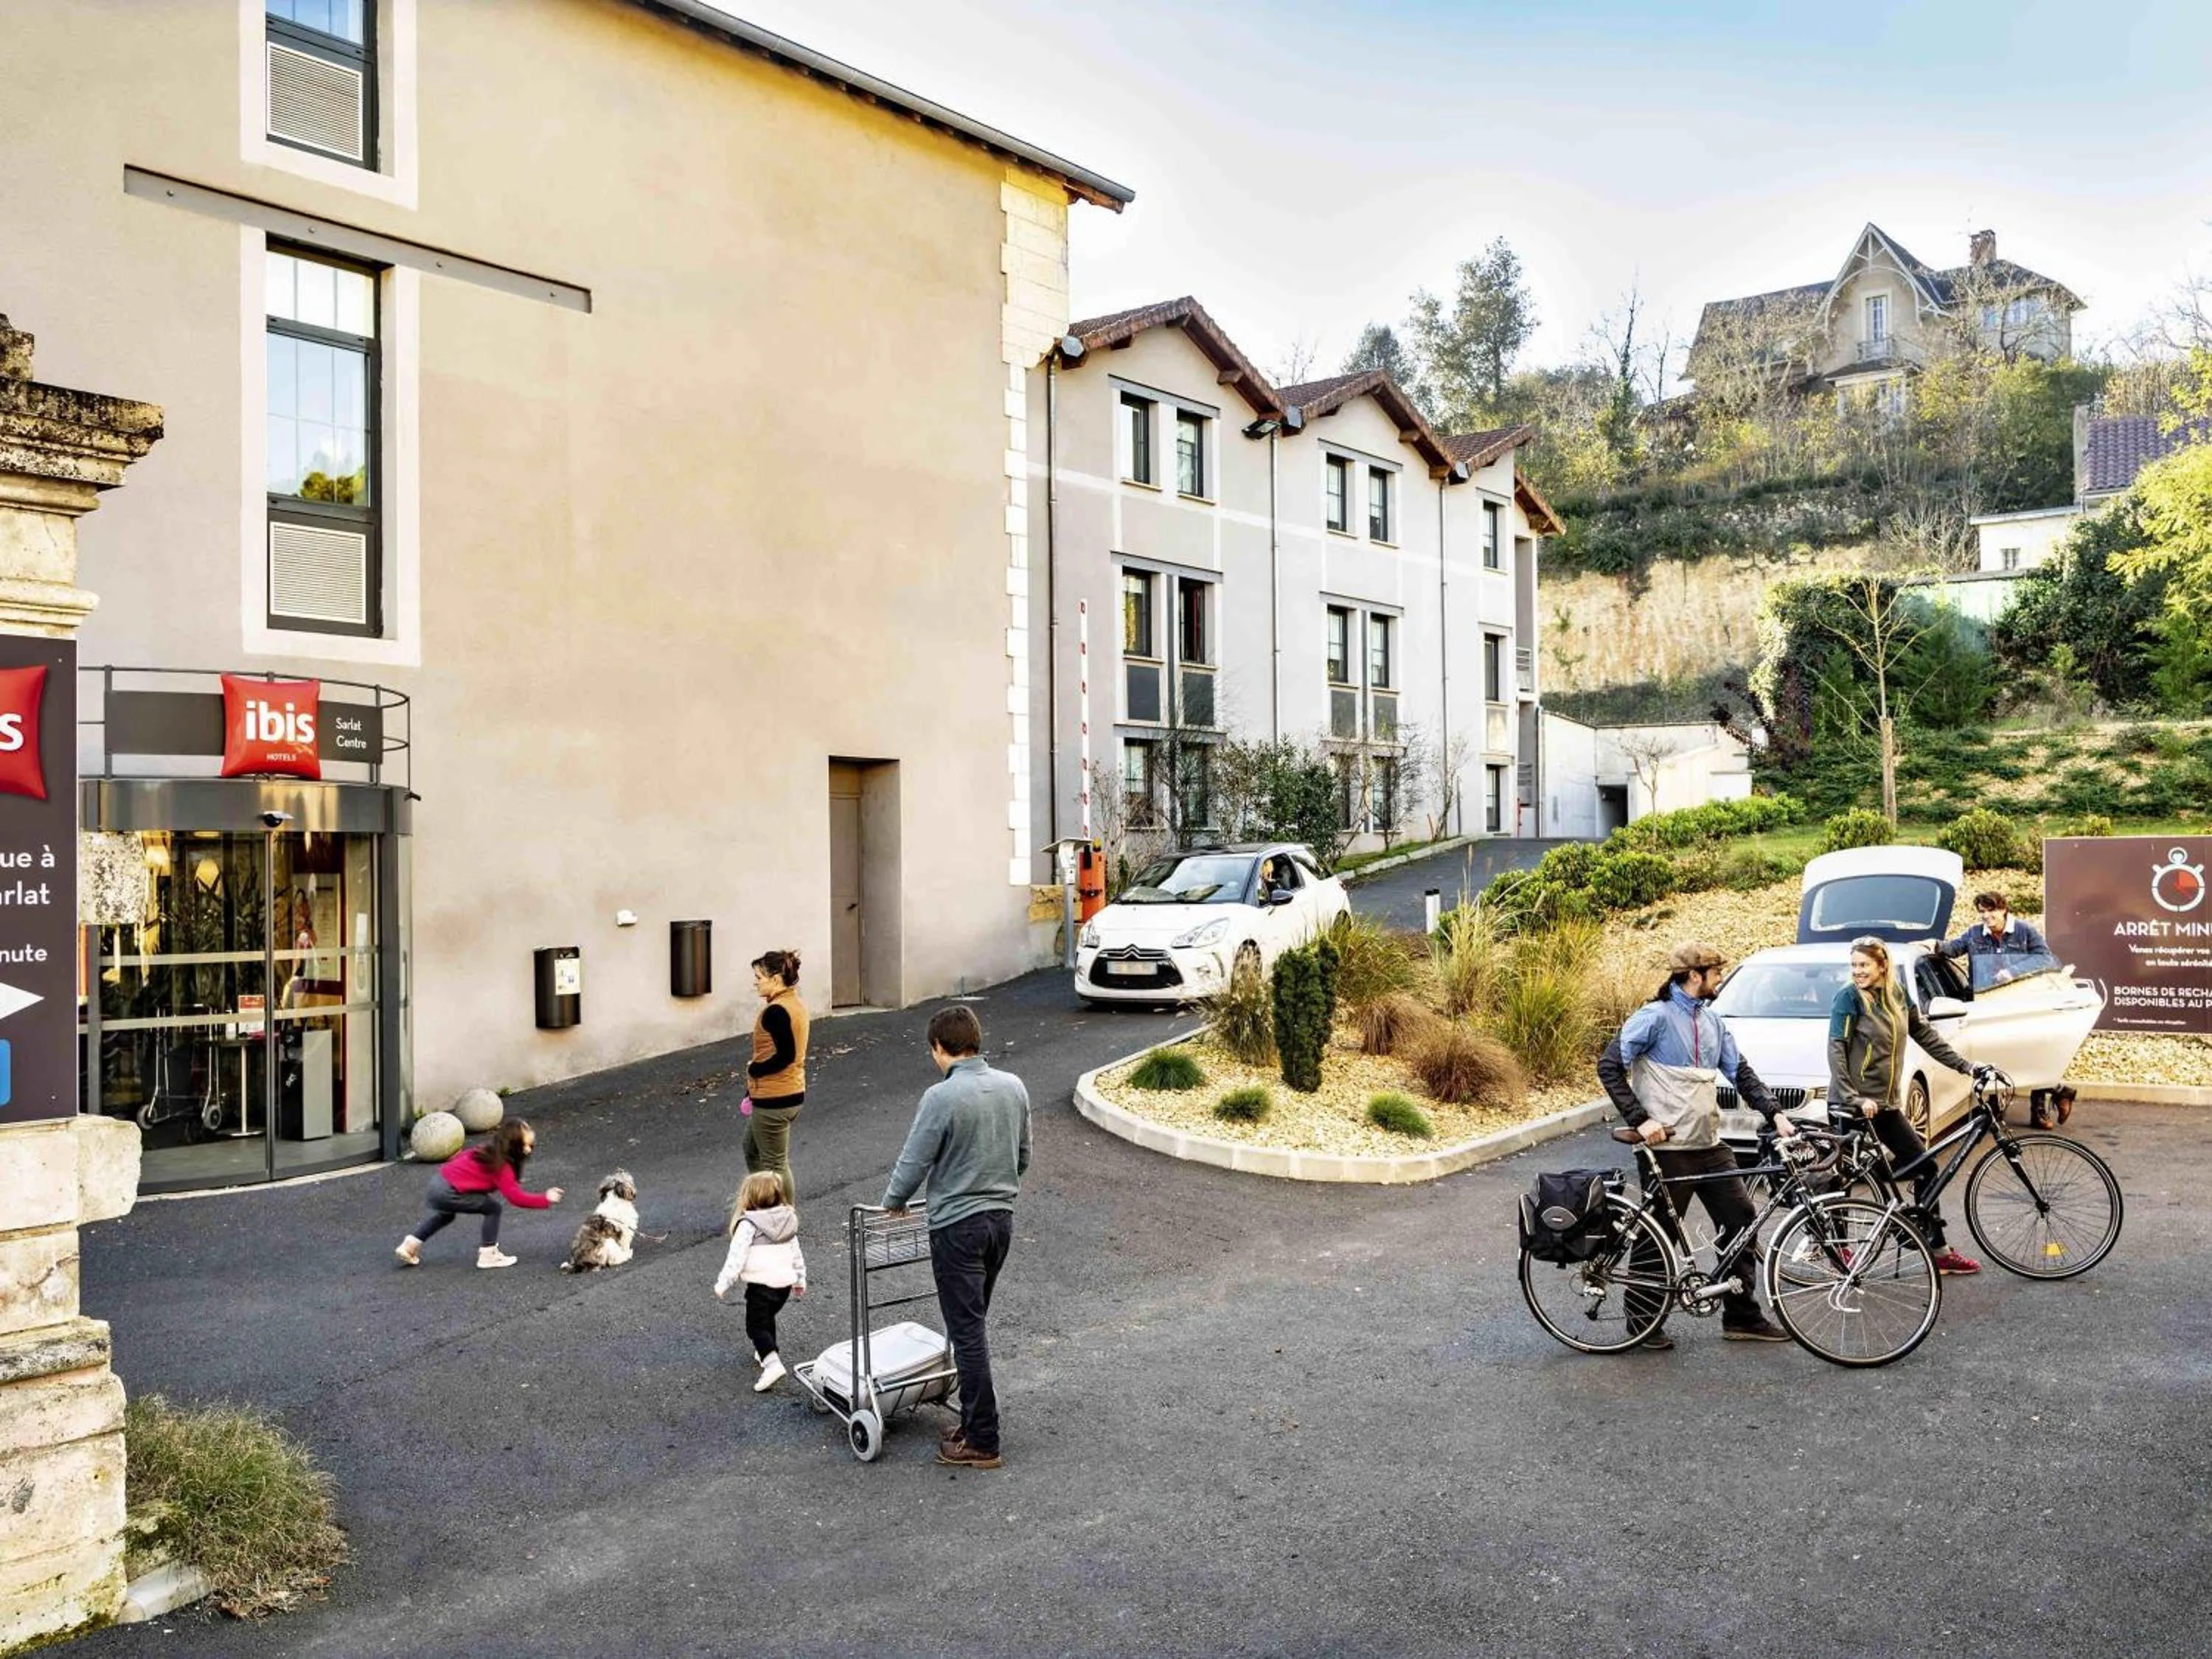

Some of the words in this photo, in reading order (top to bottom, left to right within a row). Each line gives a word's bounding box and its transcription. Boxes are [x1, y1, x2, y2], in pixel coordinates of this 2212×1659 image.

[246, 700, 316, 744] ibis
[335, 717, 363, 731] Sarlat
[335, 735, 367, 749] Centre
[266, 753, 297, 762] HOTELS
[41, 844, 55, 868] à
[0, 880, 50, 905] rlat
[2113, 919, 2171, 936] ARRÊT
[2175, 922, 2212, 937] MIN
[2114, 987, 2159, 996] BORNES
[2160, 987, 2175, 997] DE
[2114, 997, 2185, 1008] DISPONIBLES
[2188, 999, 2203, 1009] AU
